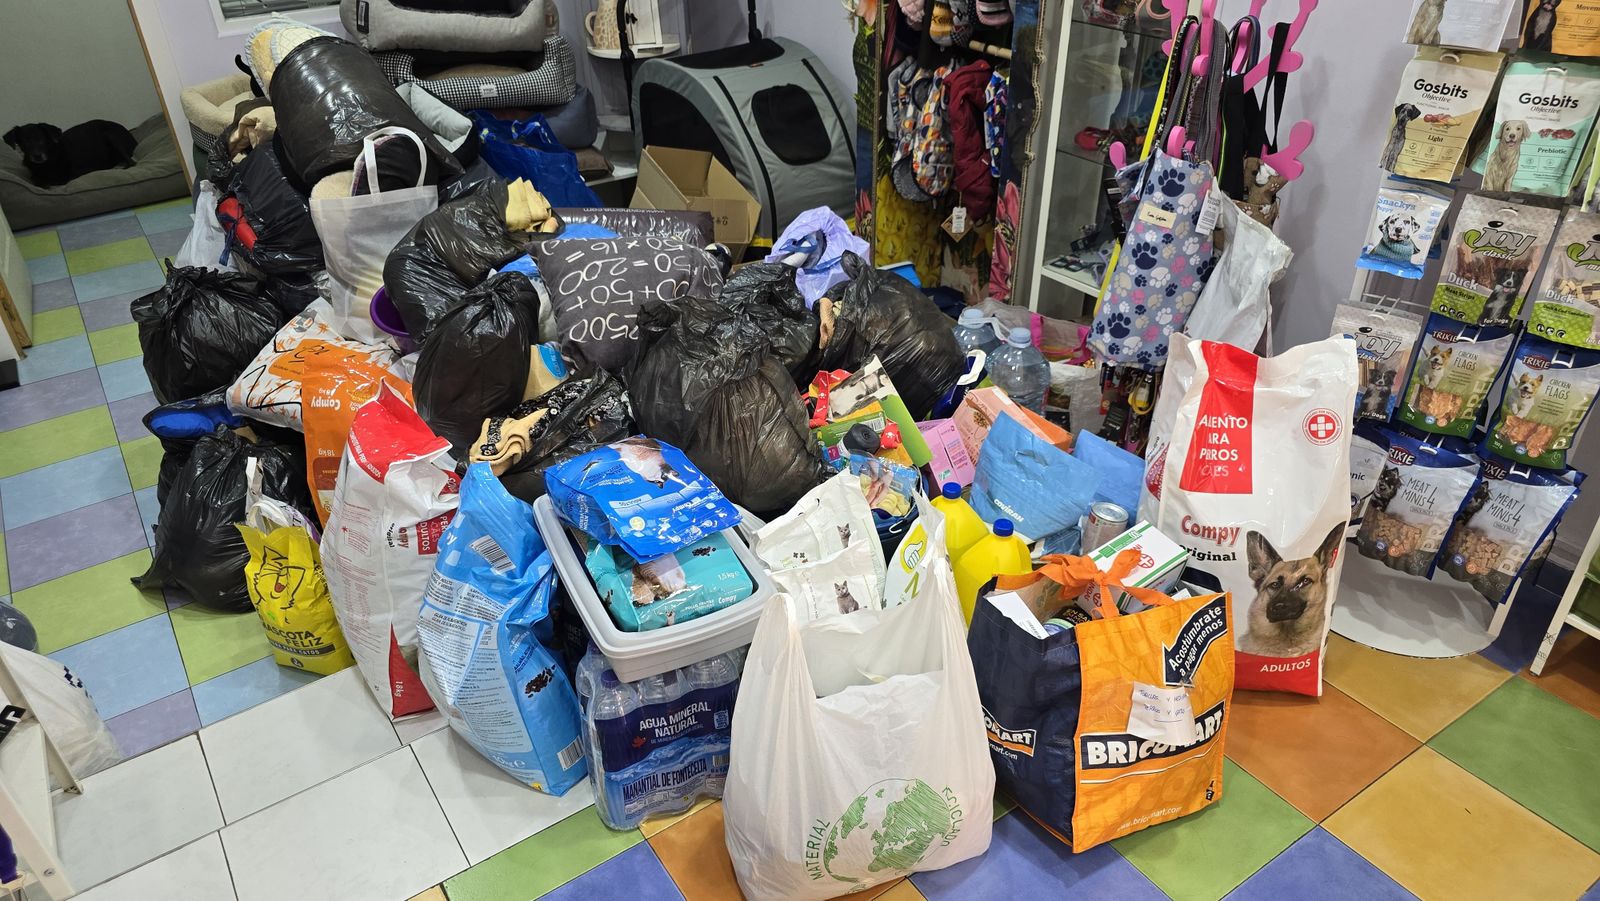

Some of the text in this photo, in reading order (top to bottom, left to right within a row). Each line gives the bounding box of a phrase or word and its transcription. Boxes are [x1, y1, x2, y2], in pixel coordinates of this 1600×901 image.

[1413, 78, 1469, 99] Gosbits
[1421, 92, 1451, 104] Objective
[1518, 92, 1580, 109] Gosbits
[1530, 105, 1561, 115] Objective
[1427, 134, 1444, 144] Light
[1537, 146, 1567, 155] Prebiotic
[1377, 195, 1417, 212] Snackys
[1482, 249, 1515, 261] classic
[1448, 271, 1479, 291] Duck
[1445, 286, 1476, 301] Meat Strips
[1545, 288, 1575, 304] Duck
[1432, 330, 1458, 343] TRIXIE
[1458, 350, 1479, 361] CHICKEN
[1522, 355, 1550, 369] TRIXIE
[1453, 357, 1477, 371] FLAGS
[1549, 378, 1571, 389] CHICKEN
[1544, 385, 1570, 400] FLAGS
[310, 395, 341, 411] Compy
[1407, 477, 1430, 494] MEAT
[1401, 489, 1427, 507] MINIS
[1495, 492, 1518, 511] MEAT
[1487, 503, 1513, 524] MINIS
[422, 521, 430, 551] DULTOS
[1181, 514, 1241, 546] Compy
[718, 595, 737, 604] Compy
[284, 636, 325, 648] FELIZ
[1168, 605, 1223, 671] Acostúmbrate
[1179, 668, 1187, 677] a
[1184, 643, 1199, 670] pagar
[1197, 619, 1224, 646] menos
[1259, 658, 1312, 673] ADULTOS
[639, 701, 712, 732] AGUA MINERAL
[655, 716, 698, 738] NATURAL
[622, 776, 661, 800] MANANTIAL
[661, 772, 672, 787] DE
[672, 758, 708, 785] FONTECELTA
[804, 818, 832, 881] MATERIAL
